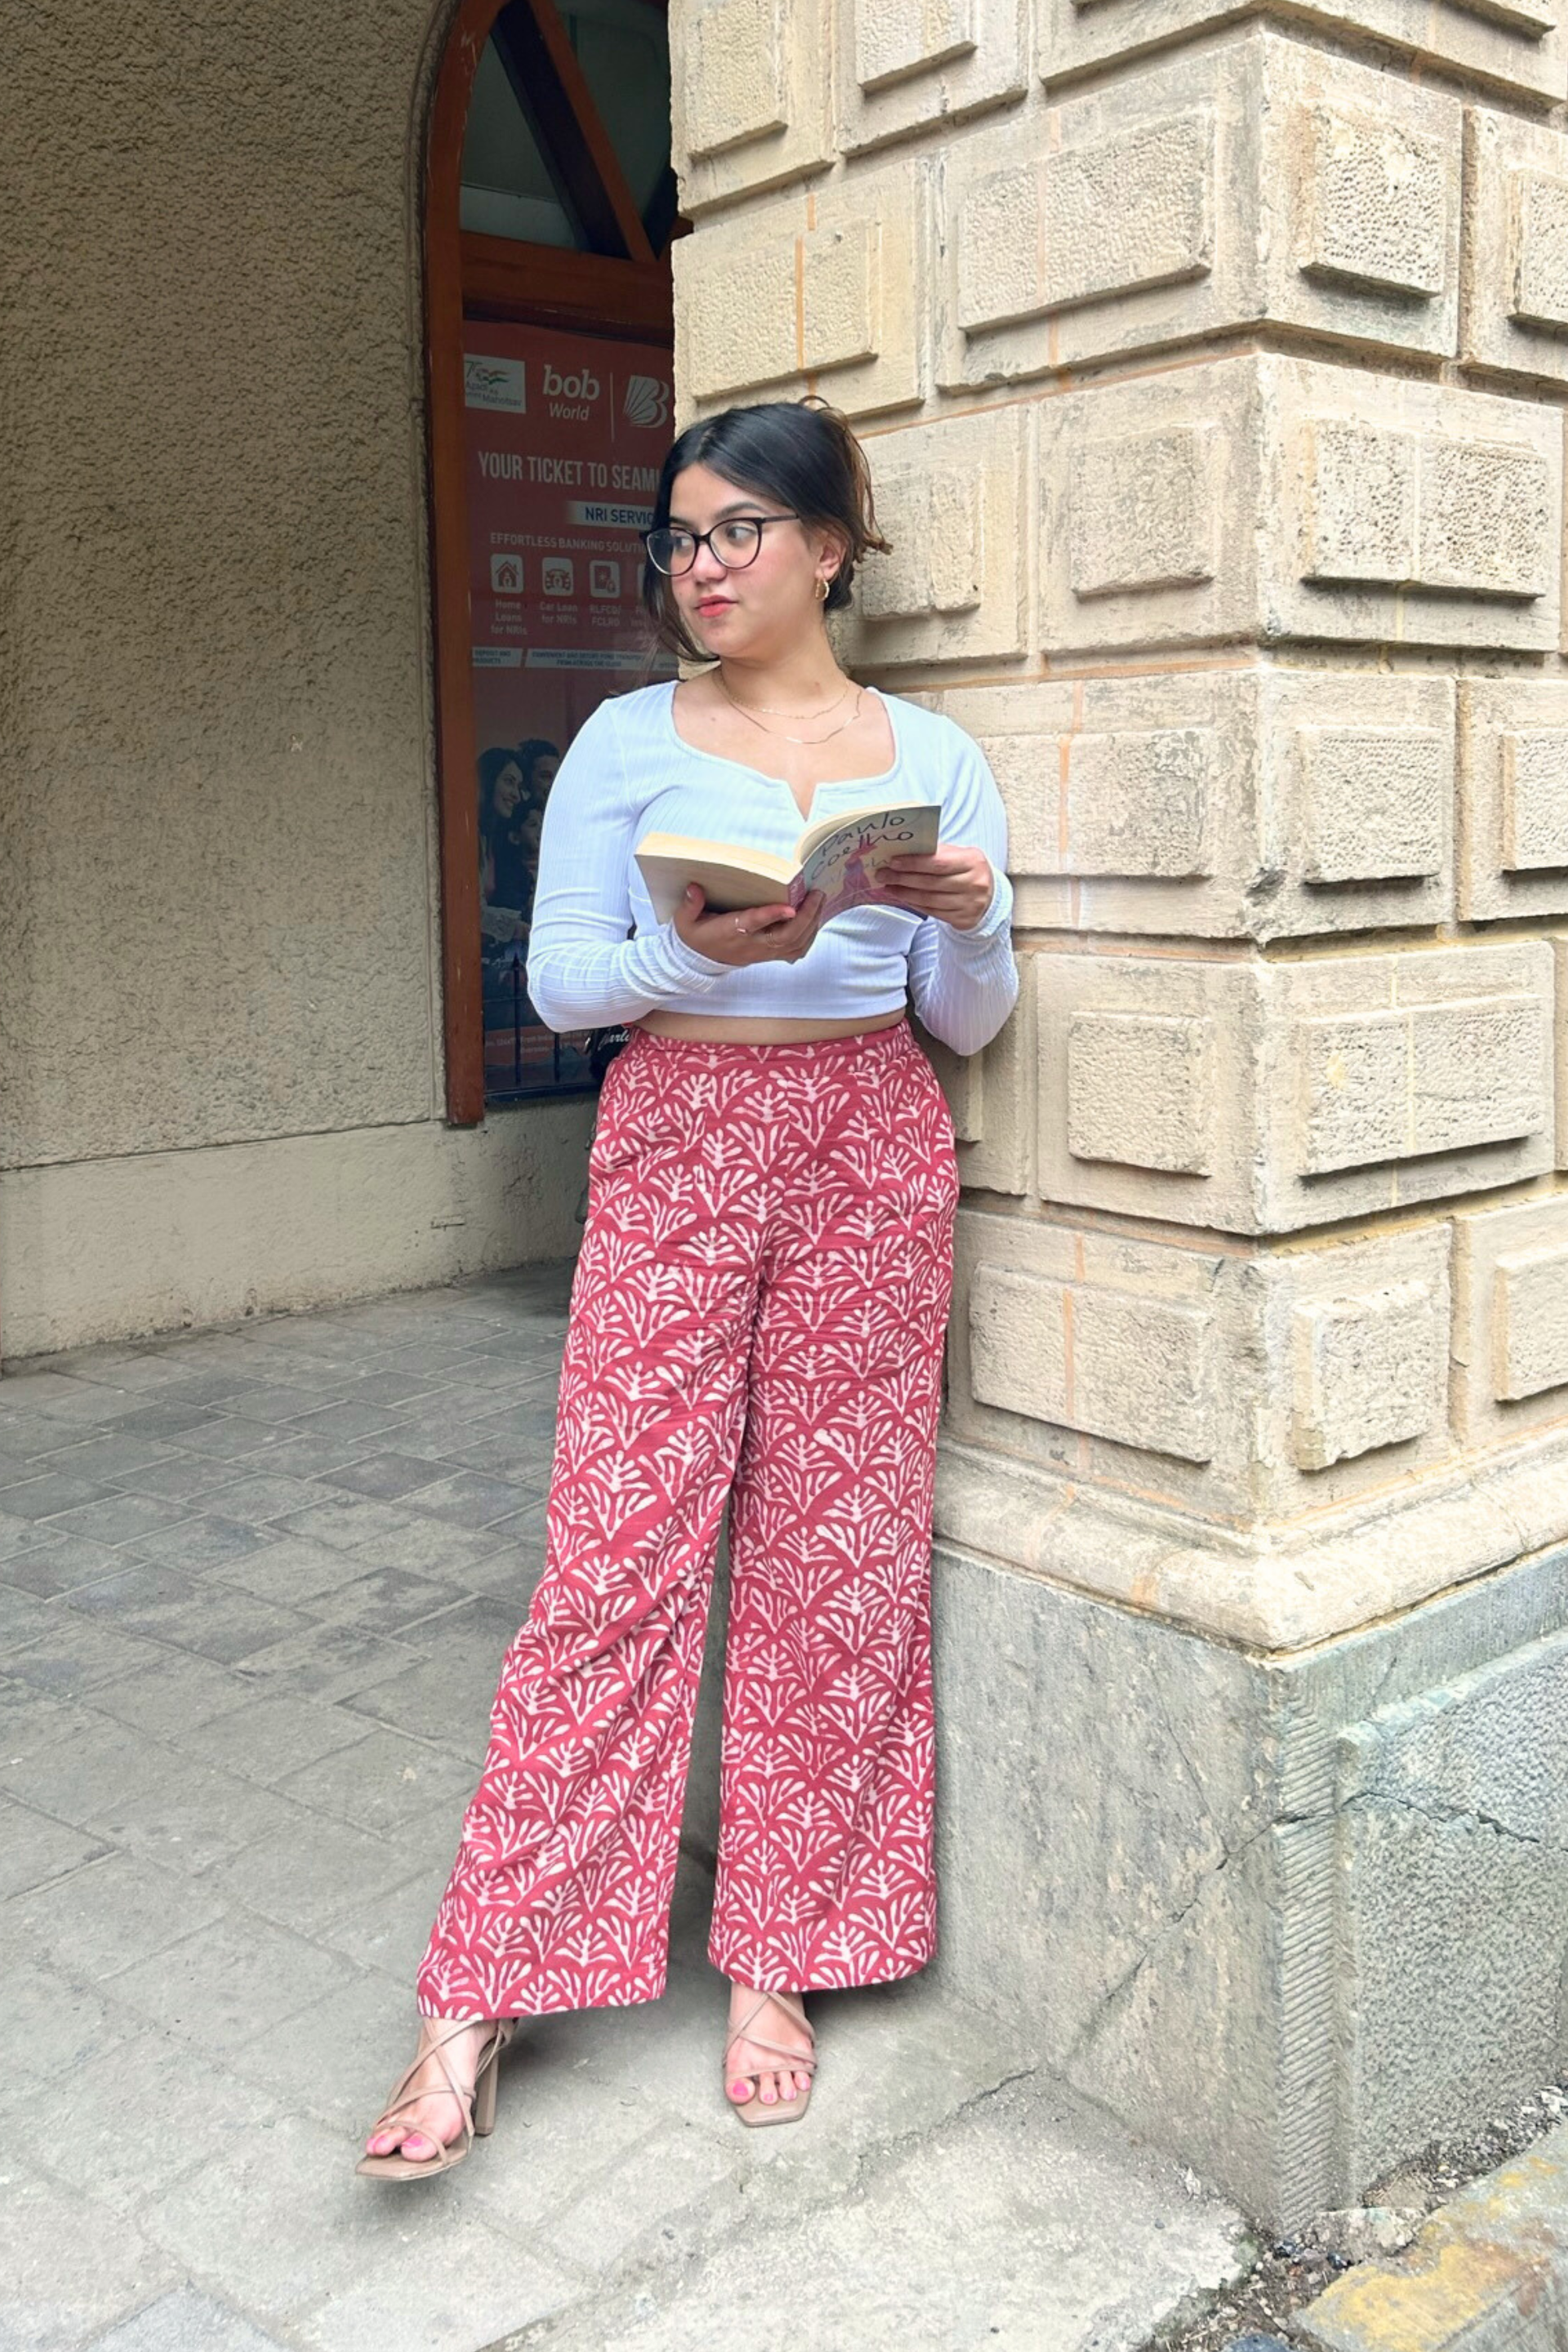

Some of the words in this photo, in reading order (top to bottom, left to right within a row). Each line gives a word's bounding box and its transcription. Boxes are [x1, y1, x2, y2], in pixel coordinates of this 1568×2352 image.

[542, 364, 600, 400] bob
[549, 403, 590, 421] World
[478, 451, 523, 480] YOUR
[528, 456, 583, 486] TICKET
[588, 461, 608, 488] TO
[585, 506, 608, 522] NRI
[491, 532, 557, 549] EFFORTLESS
[559, 537, 605, 551] BANKING
[495, 599, 521, 610] Home
[539, 600, 555, 611] Car
[556, 602, 578, 612] Loan
[495, 612, 522, 622] Loans
[541, 614, 555, 624] for
[491, 625, 505, 635] for
